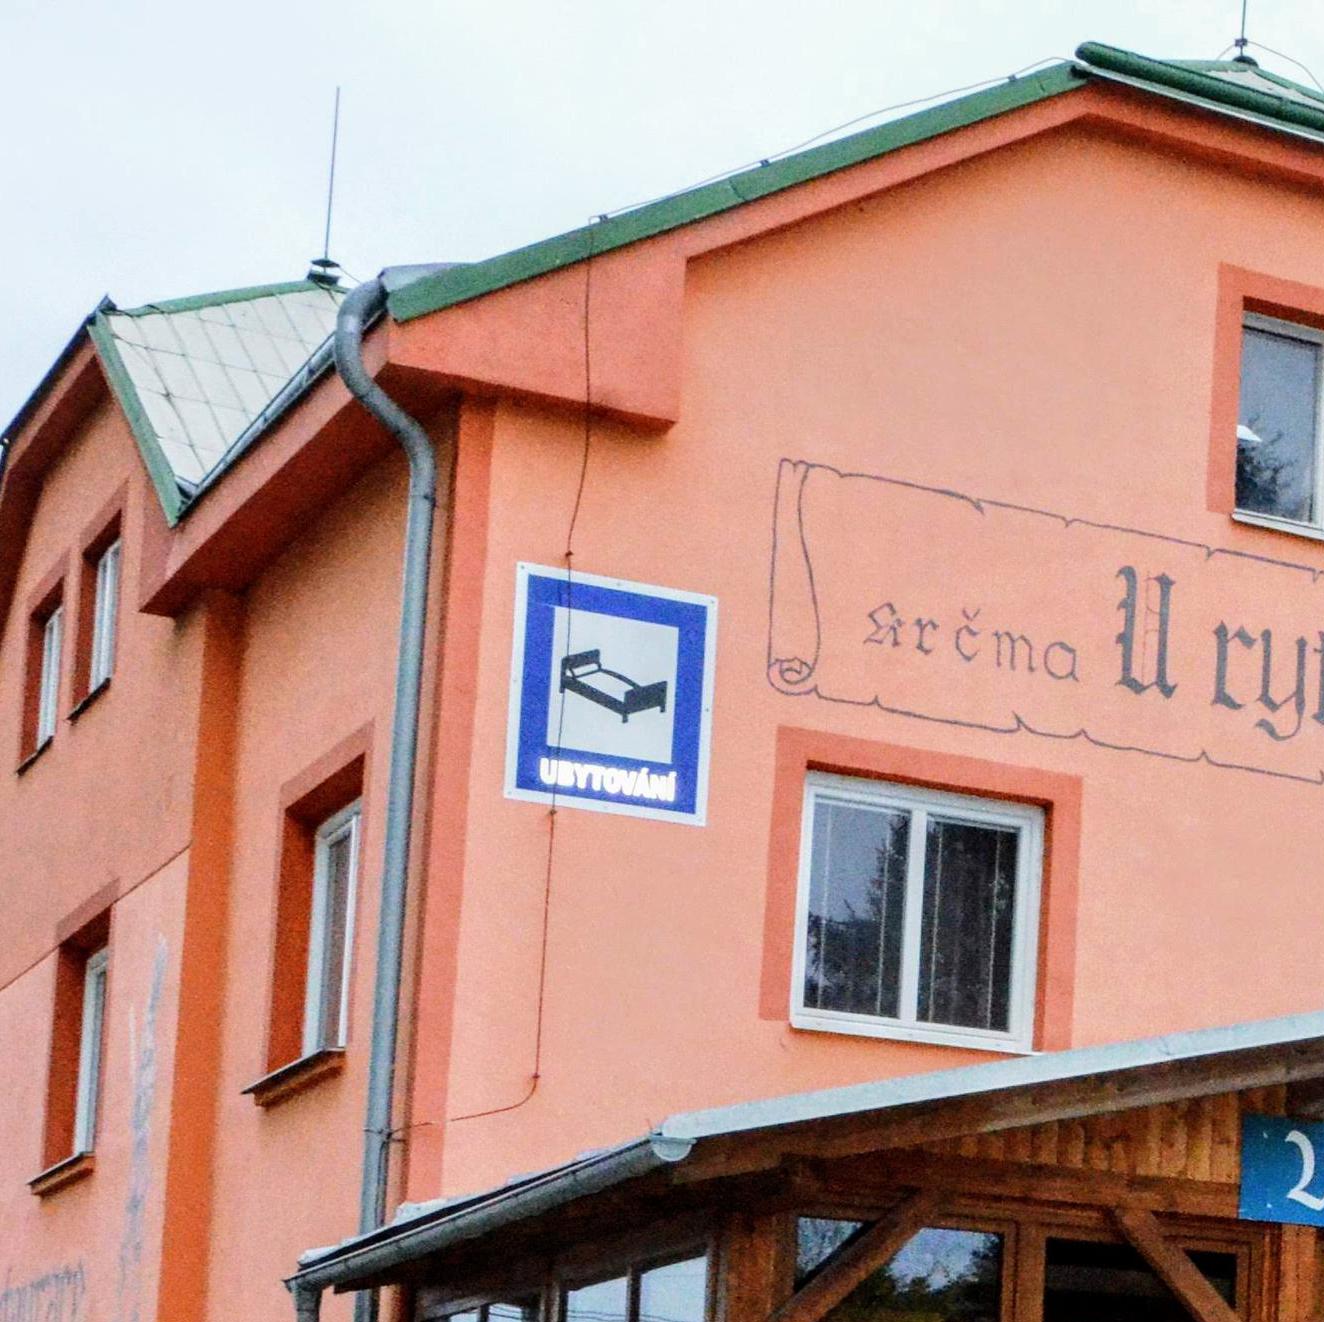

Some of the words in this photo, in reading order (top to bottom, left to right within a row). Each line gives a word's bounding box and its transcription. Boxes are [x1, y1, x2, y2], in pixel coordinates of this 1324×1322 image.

[863, 602, 1079, 682] Krčma
[1114, 565, 1177, 700] U
[538, 757, 677, 802] UBYTOVÁNÍ
